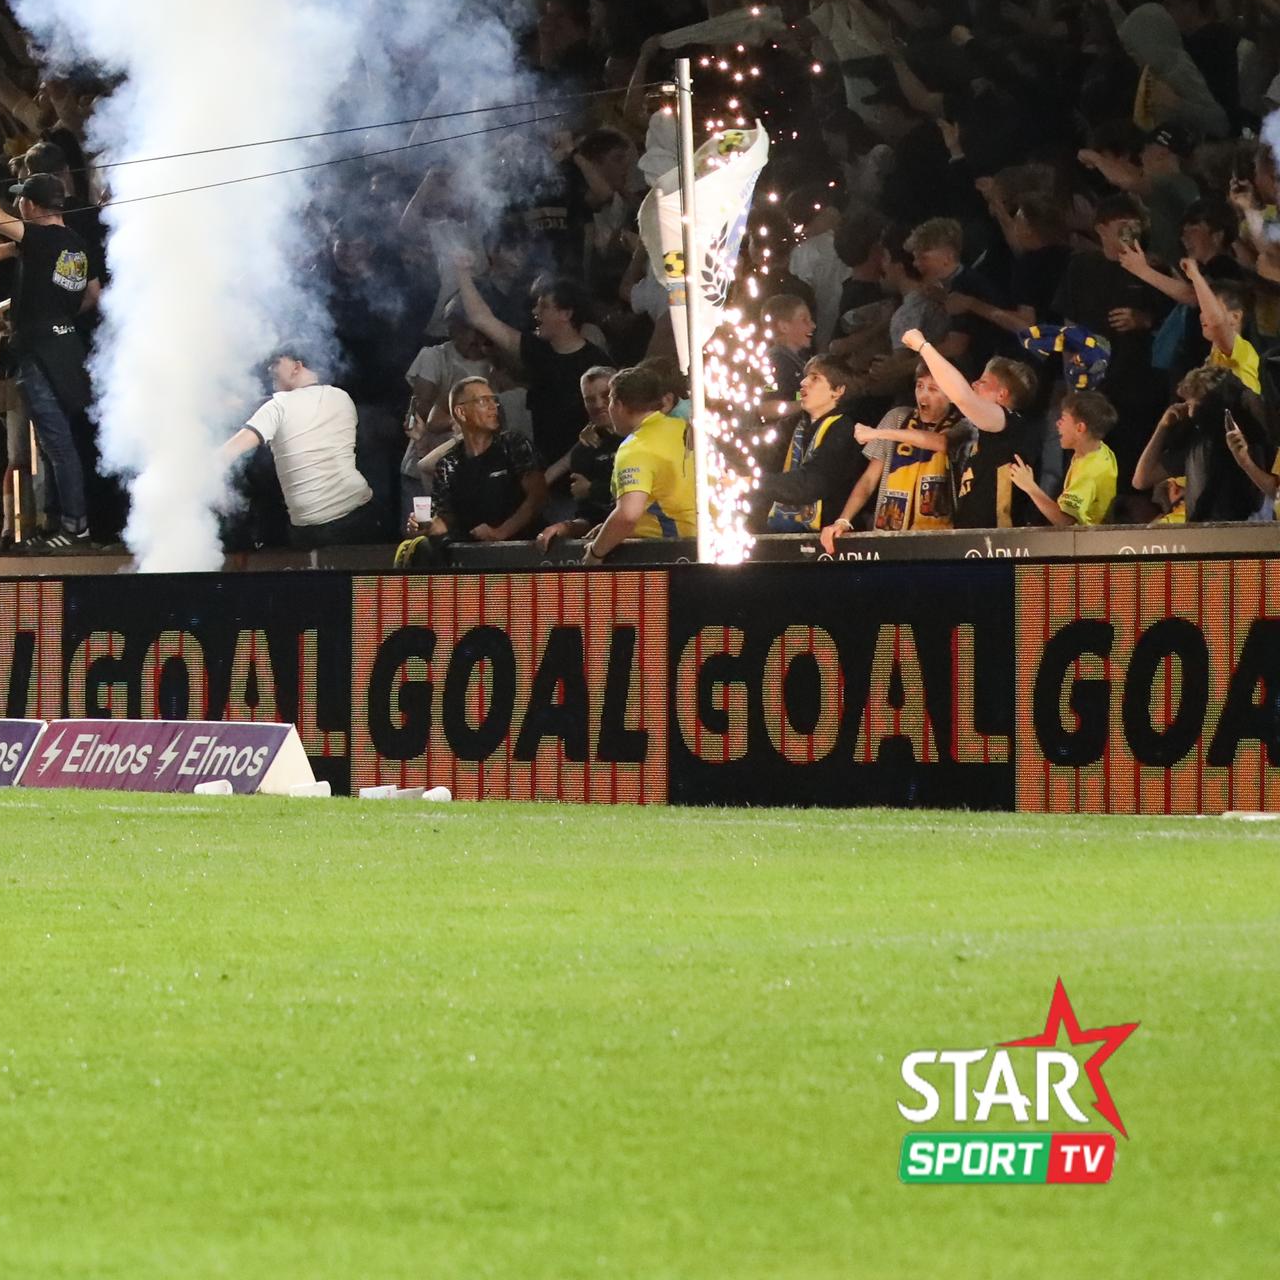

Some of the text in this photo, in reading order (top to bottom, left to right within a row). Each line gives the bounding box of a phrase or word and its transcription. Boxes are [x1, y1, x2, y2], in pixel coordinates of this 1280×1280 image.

[68, 628, 348, 758] GOAL
[368, 623, 651, 764] GOAL
[675, 621, 1012, 764] GOAL
[61, 732, 152, 776] Elmos
[178, 734, 270, 777] Elmos
